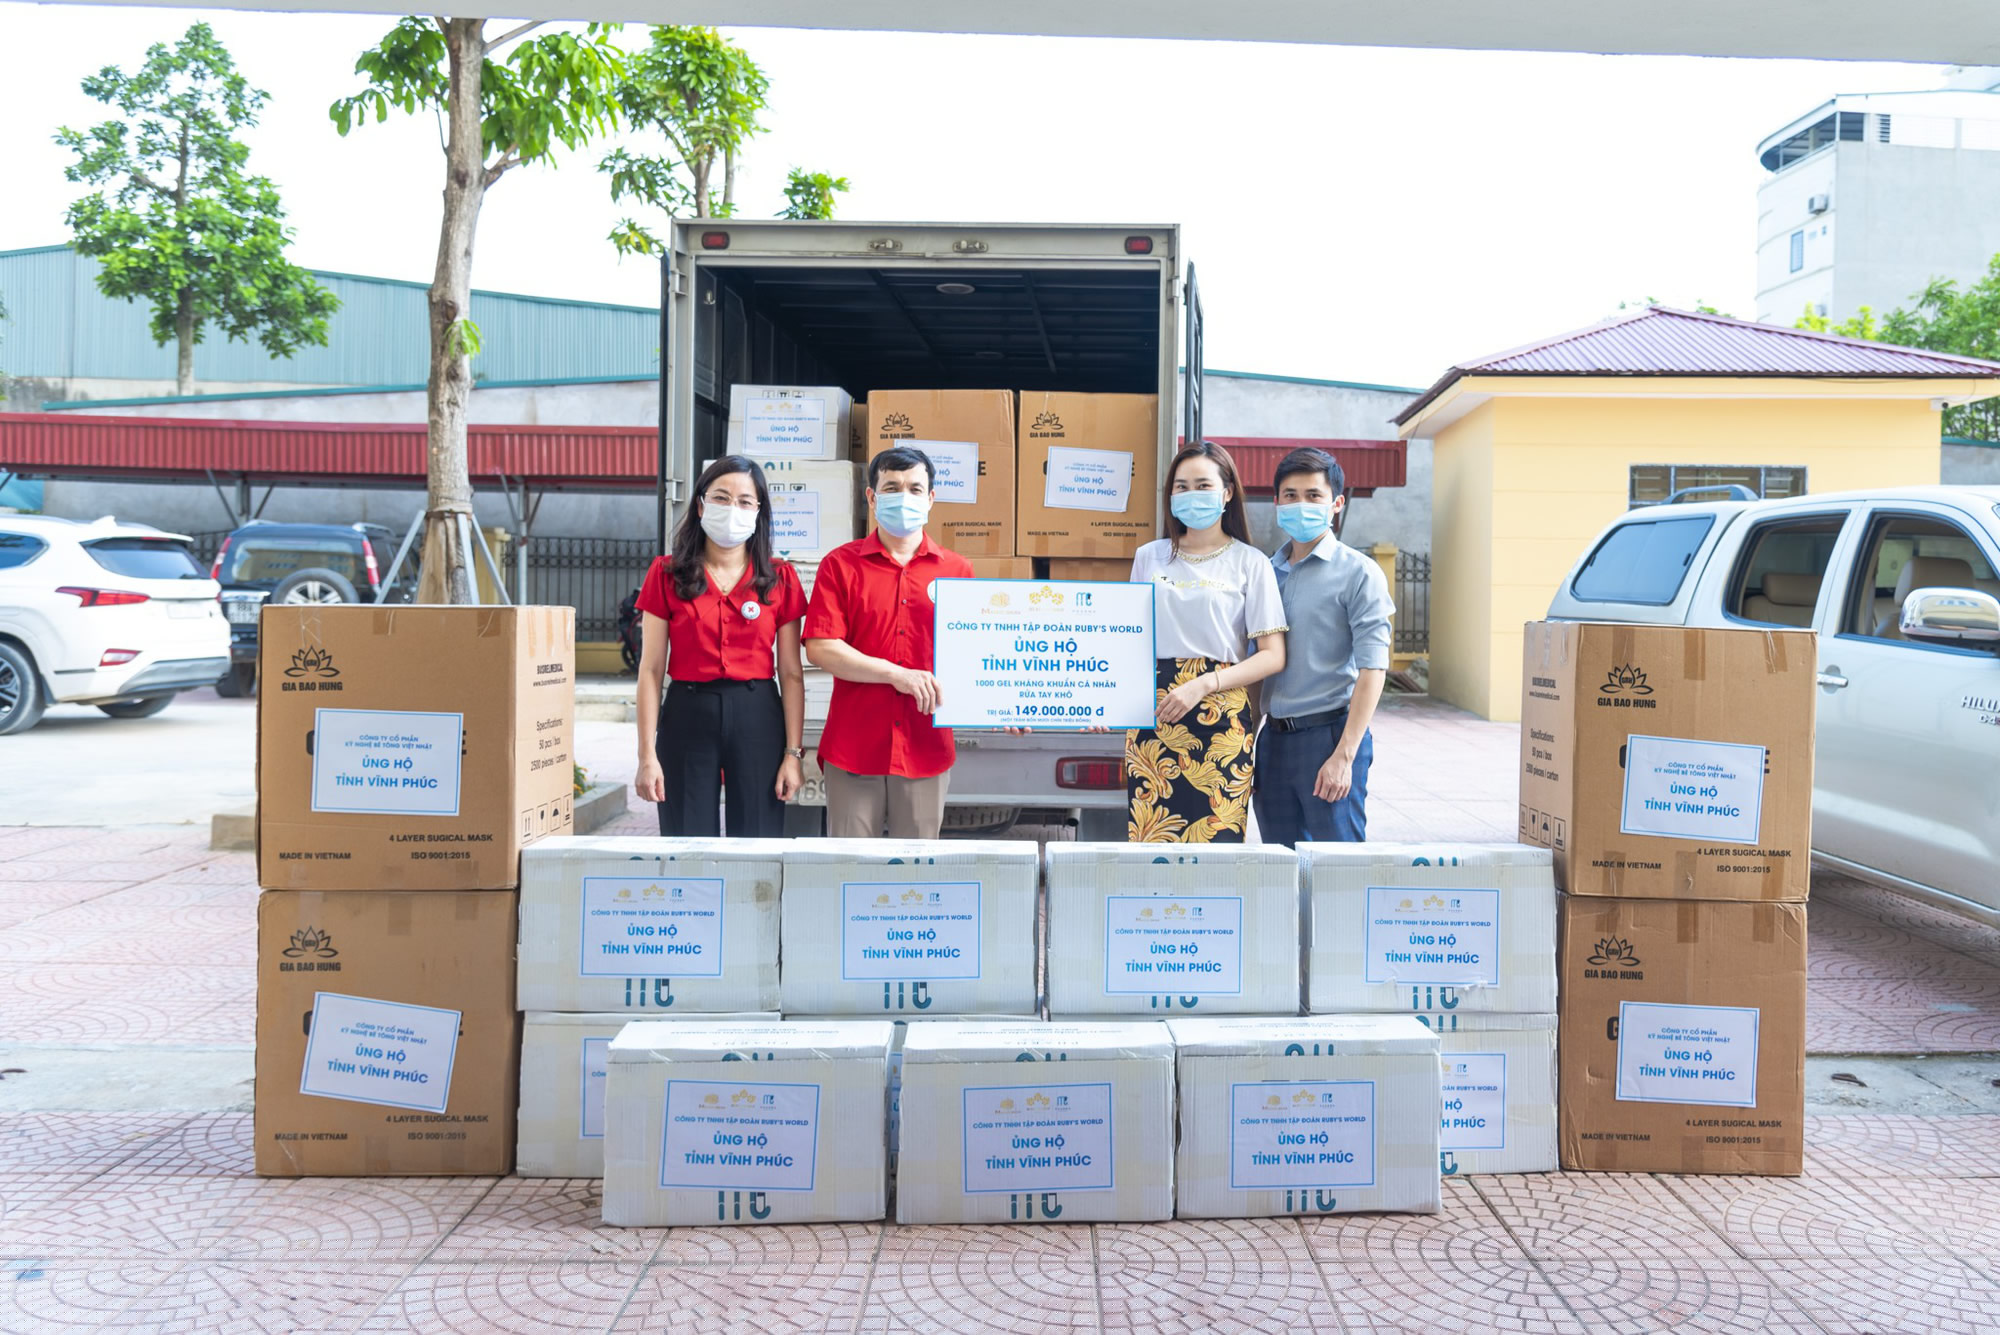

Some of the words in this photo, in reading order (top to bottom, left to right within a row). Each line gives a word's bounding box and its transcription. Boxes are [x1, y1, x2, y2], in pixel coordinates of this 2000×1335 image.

[947, 621, 978, 630] CÔNG
[994, 623, 1020, 631] TNHH
[1043, 623, 1072, 632] ĐOÀN
[1075, 624, 1107, 633] RUBY'S
[1109, 625, 1143, 634] WORLD
[1015, 636, 1048, 653] ỦNG
[1054, 637, 1078, 656] HỘ
[982, 655, 1017, 671] TỈNH
[1023, 656, 1060, 671] VĨNH
[1066, 656, 1109, 672] PHÚC
[282, 682, 297, 691] GIA
[299, 682, 316, 691] BAO
[318, 681, 343, 691] HUNG
[1597, 697, 1612, 707] GIA
[1614, 698, 1631, 708] BAO
[1633, 699, 1656, 708] HUNG
[1961, 696, 2000, 713] HILU
[1015, 705, 1092, 716] 149.000.000
[1095, 706, 1104, 716] đ
[362, 755, 390, 768] ỦNG
[394, 757, 413, 772] HỘ
[336, 773, 363, 786] TỈNH
[368, 775, 398, 787] VĨNH
[402, 776, 438, 789] PHÚC
[1670, 782, 1696, 796] ỦNG
[1700, 785, 1718, 800] HỘ
[1645, 798, 1671, 811] TỈNH
[1675, 801, 1704, 814] VĨNH
[1707, 804, 1740, 817] PHÚC
[389, 834, 394, 842] 4
[396, 834, 425, 842] LAYER
[427, 834, 466, 842] SUGICAL
[467, 834, 493, 842] MASK
[314, 852, 351, 860] VIETNAM
[411, 852, 427, 860] ISO
[428, 851, 471, 859] 9001:2015
[1704, 848, 1730, 856] LAYER
[1732, 849, 1767, 857] SUGICAL
[1768, 850, 1791, 858] MASK
[1592, 860, 1614, 868] MADE
[1732, 866, 1771, 874] 9001:2015
[628, 923, 655, 936] ỦNG
[658, 924, 678, 939] HỘ
[887, 928, 914, 940] ỦNG
[918, 928, 936, 942] HỘ
[1409, 932, 1435, 945] ỦNG
[1438, 933, 1456, 948] HỘ
[602, 941, 629, 954] TỈNH
[633, 942, 663, 954] VĨNH
[667, 942, 702, 955] PHÚC
[862, 946, 889, 959] TỈNH
[893, 947, 923, 959] VĨNH
[927, 946, 960, 958] PHÚC
[1150, 941, 1176, 954] ỦNG
[1180, 942, 1198, 957] HỘ
[1385, 950, 1411, 962] TỈNH
[1415, 951, 1443, 963] VĨNH
[1447, 951, 1479, 964] PHÚC
[280, 962, 294, 972] GIA
[297, 962, 315, 972] BAO
[316, 962, 341, 971] HUNG
[1126, 959, 1152, 972] TỈNH
[1156, 960, 1185, 972] VĨNH
[1189, 960, 1222, 973] PHÚC
[1584, 969, 1599, 978] GIA
[1601, 970, 1618, 979] BAO
[1620, 970, 1643, 980] HUNG
[386, 1049, 406, 1064] HỘ
[1664, 1047, 1690, 1061] ỦNG
[1694, 1049, 1712, 1064] HỘ
[328, 1060, 356, 1074] TỈNH
[359, 1064, 390, 1078] VĨNH
[393, 1070, 428, 1084] PHÚC
[1639, 1064, 1666, 1077] TỈNH
[1670, 1066, 1699, 1079] VĨNH
[1702, 1068, 1735, 1081] PHÚC
[1444, 1098, 1463, 1113] HỘ
[386, 1115, 391, 1123] 4
[393, 1115, 422, 1123] LAYER
[424, 1115, 462, 1123] SUGICAL
[1453, 1116, 1486, 1128] PHÚC
[1692, 1119, 1720, 1127] LAYER
[1721, 1120, 1757, 1128] SUGICAL
[1758, 1120, 1782, 1128] MASK
[408, 1132, 424, 1140] ISO
[425, 1132, 466, 1140] 9001:2015
[713, 1131, 743, 1146] ỦNG
[747, 1133, 768, 1149] HỘ
[1012, 1135, 1041, 1149] ỦNG
[1045, 1134, 1065, 1150] HỘ
[1278, 1131, 1306, 1145] ỦNG
[1310, 1131, 1329, 1146] HỘ
[1722, 1136, 1761, 1144] 9001:2015
[685, 1151, 715, 1164] TỈNH
[719, 1152, 752, 1166] VĨNH
[756, 1153, 793, 1167] PHÚC
[986, 1155, 1015, 1169] TỈNH
[1019, 1155, 1051, 1168] VĨNH
[1055, 1153, 1091, 1167] PHÚC
[1252, 1151, 1280, 1165] TỈNH
[1284, 1152, 1315, 1164] VĨNH
[1319, 1150, 1354, 1164] PHÚC
